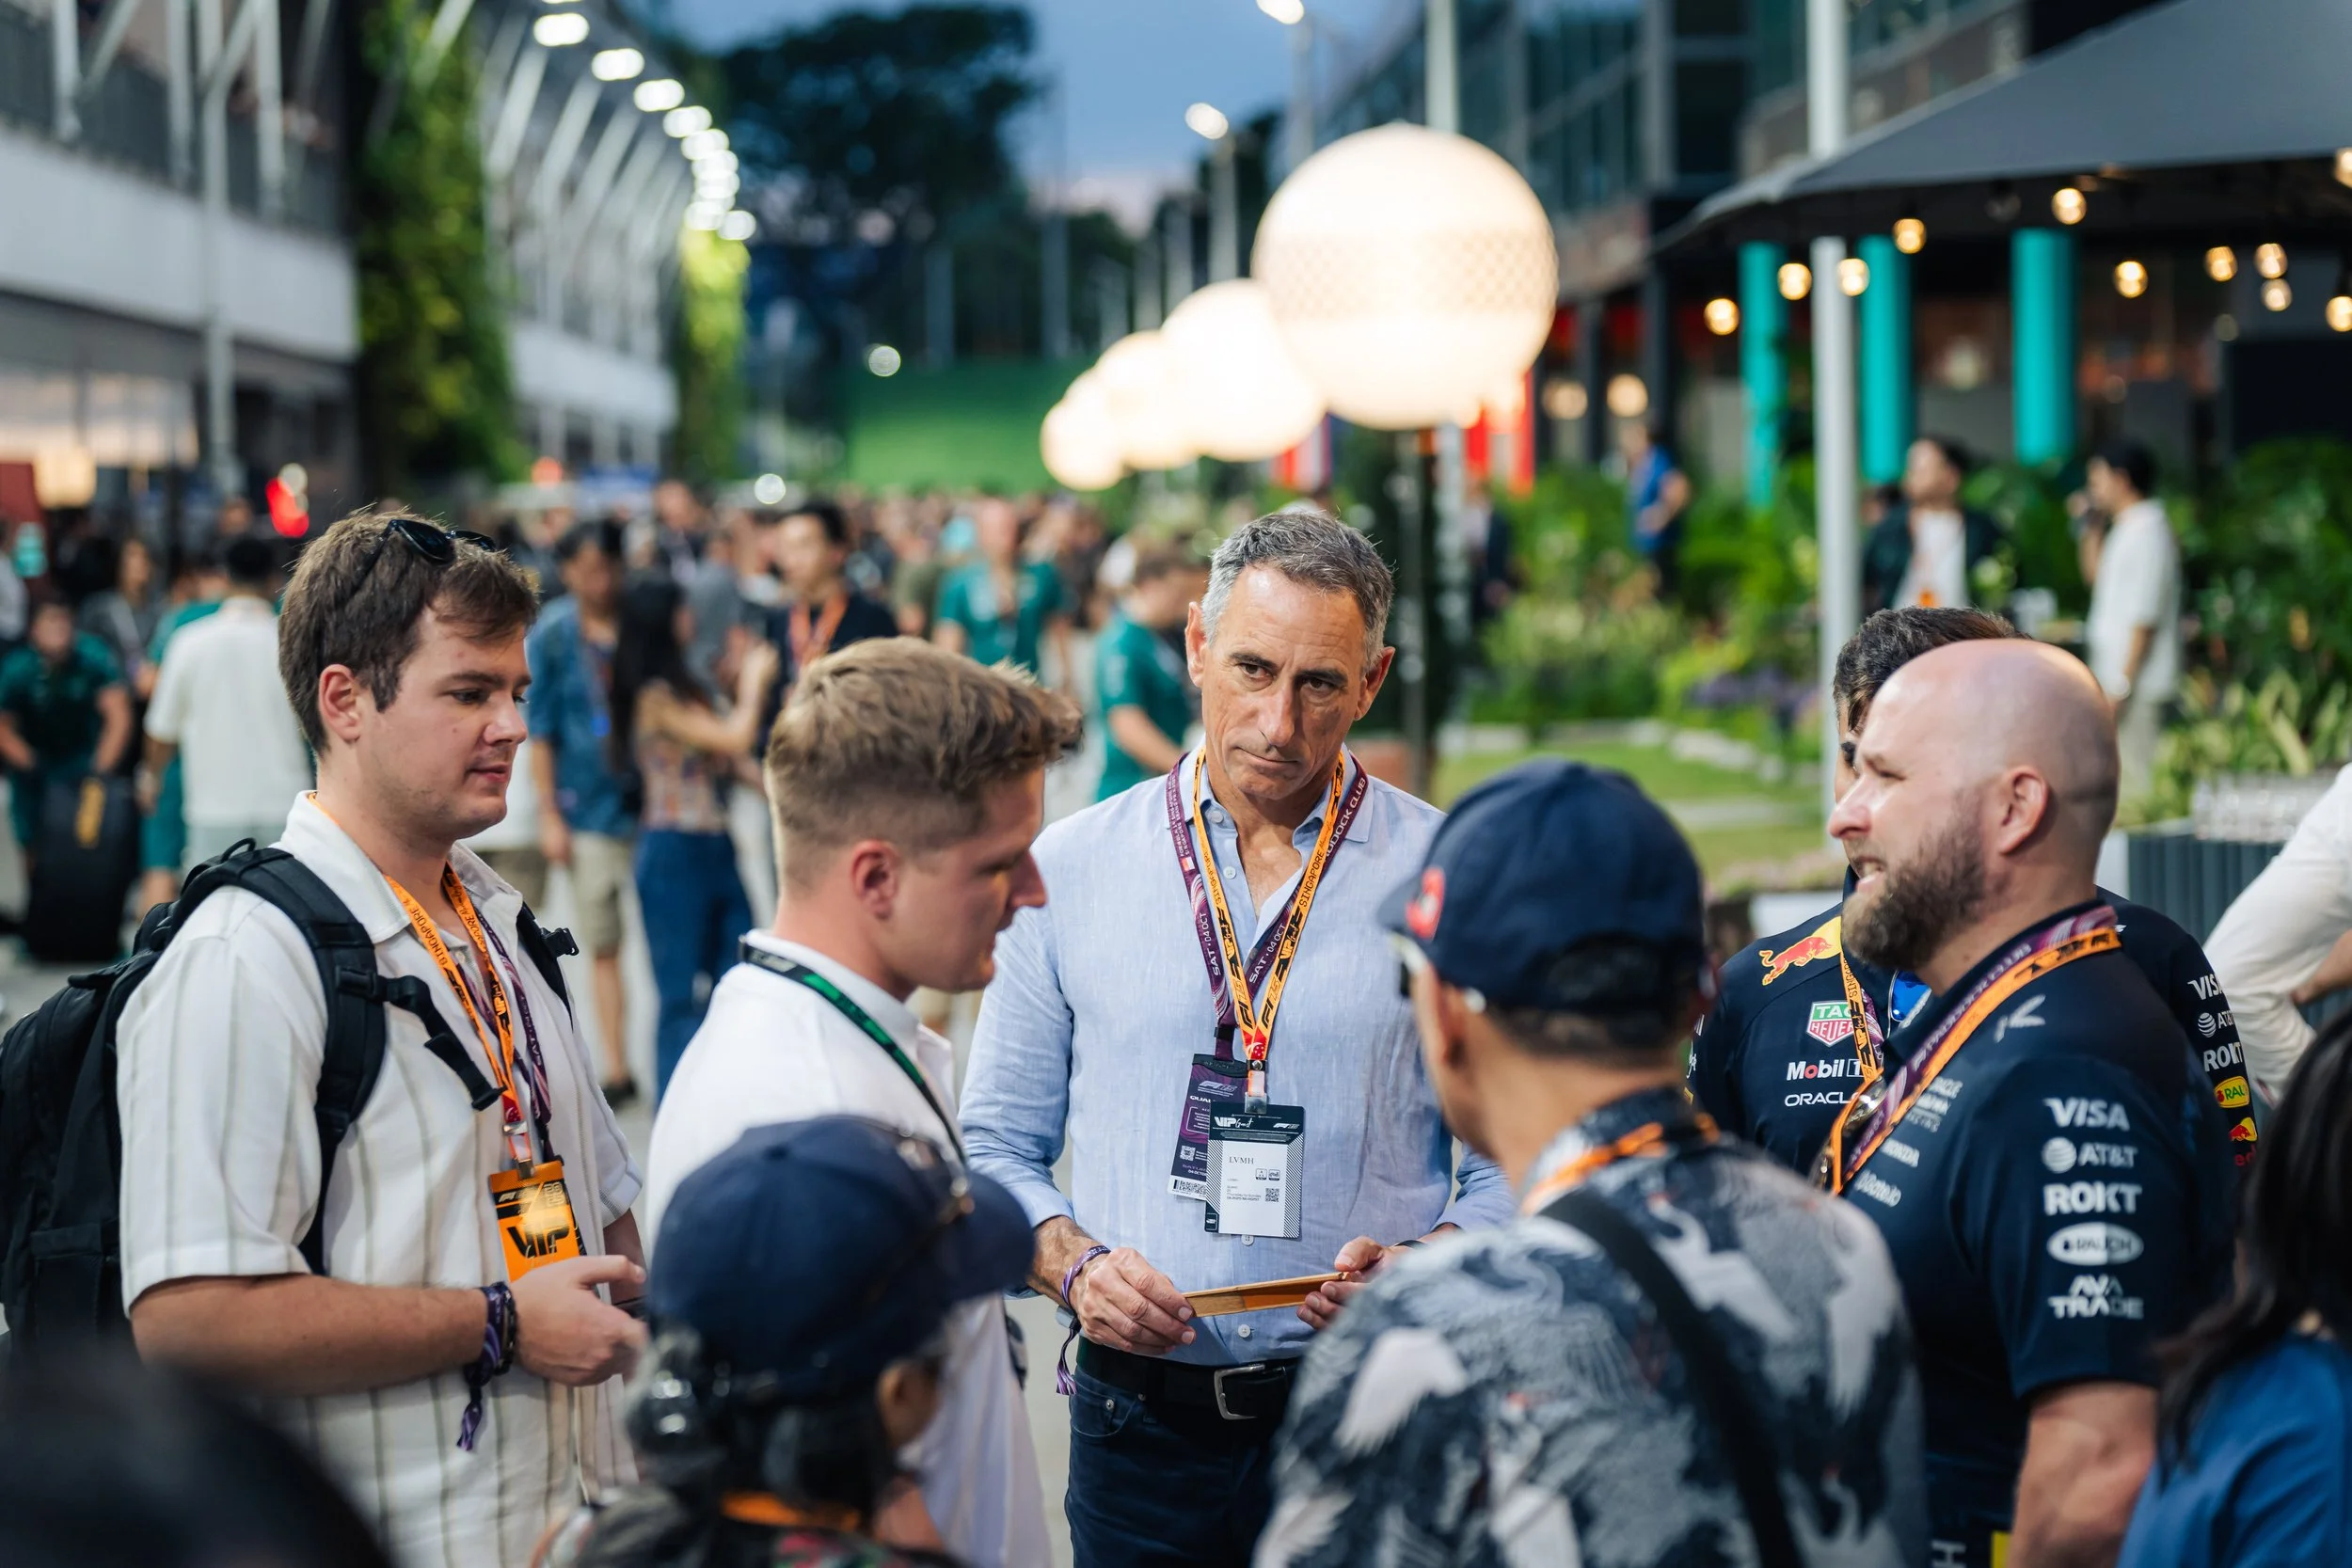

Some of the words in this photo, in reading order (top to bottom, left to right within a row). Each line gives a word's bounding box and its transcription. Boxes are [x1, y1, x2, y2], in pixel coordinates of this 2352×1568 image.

[1350, 777, 1366, 809] CLUB
[1299, 850, 1325, 908] SINGAPORE
[1200, 912, 1209, 929] OCT
[1203, 930, 1212, 942] 04
[1249, 956, 1267, 983] SAT
[1266, 941, 1277, 954] 04
[1274, 924, 1287, 942] OCT
[1280, 939, 1294, 959] VIP
[1207, 949, 1221, 975] SAT
[1787, 1059, 1845, 1081] Mobil
[1214, 1117, 1236, 1127] VIP
[2043, 1098, 2130, 1130] VISA
[1229, 1156, 1254, 1164] LVMH
[2078, 1143, 2137, 1168] AT&T
[2043, 1182, 2142, 1215] ROKT
[506, 1225, 570, 1259] VIP
[2069, 1275, 2123, 1296] AVA
[2048, 1296, 2144, 1319] TRADE
